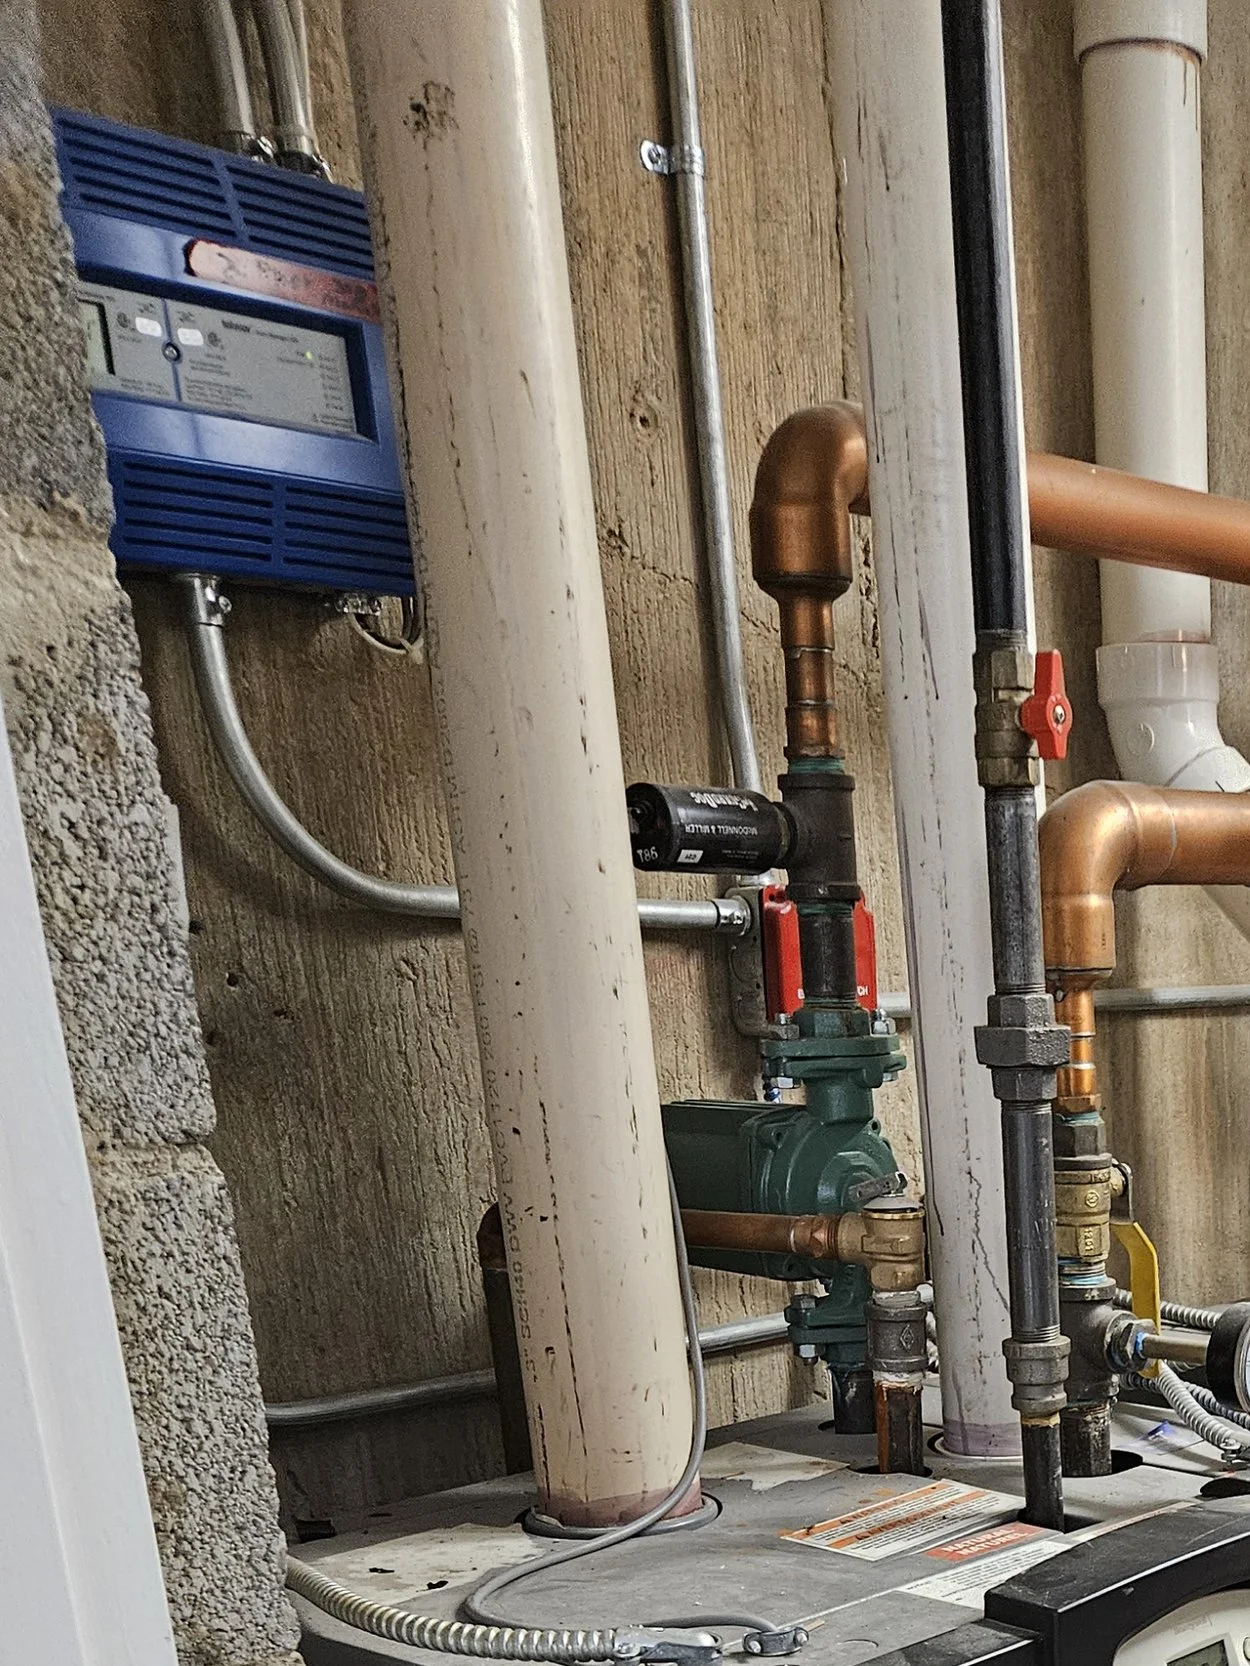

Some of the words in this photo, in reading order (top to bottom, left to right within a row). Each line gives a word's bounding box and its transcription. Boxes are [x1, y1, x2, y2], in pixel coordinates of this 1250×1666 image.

[501, 1191, 520, 1252] DWV
[942, 1528, 1014, 1553] NATURAL
[956, 1532, 1029, 1556] NATUREL
